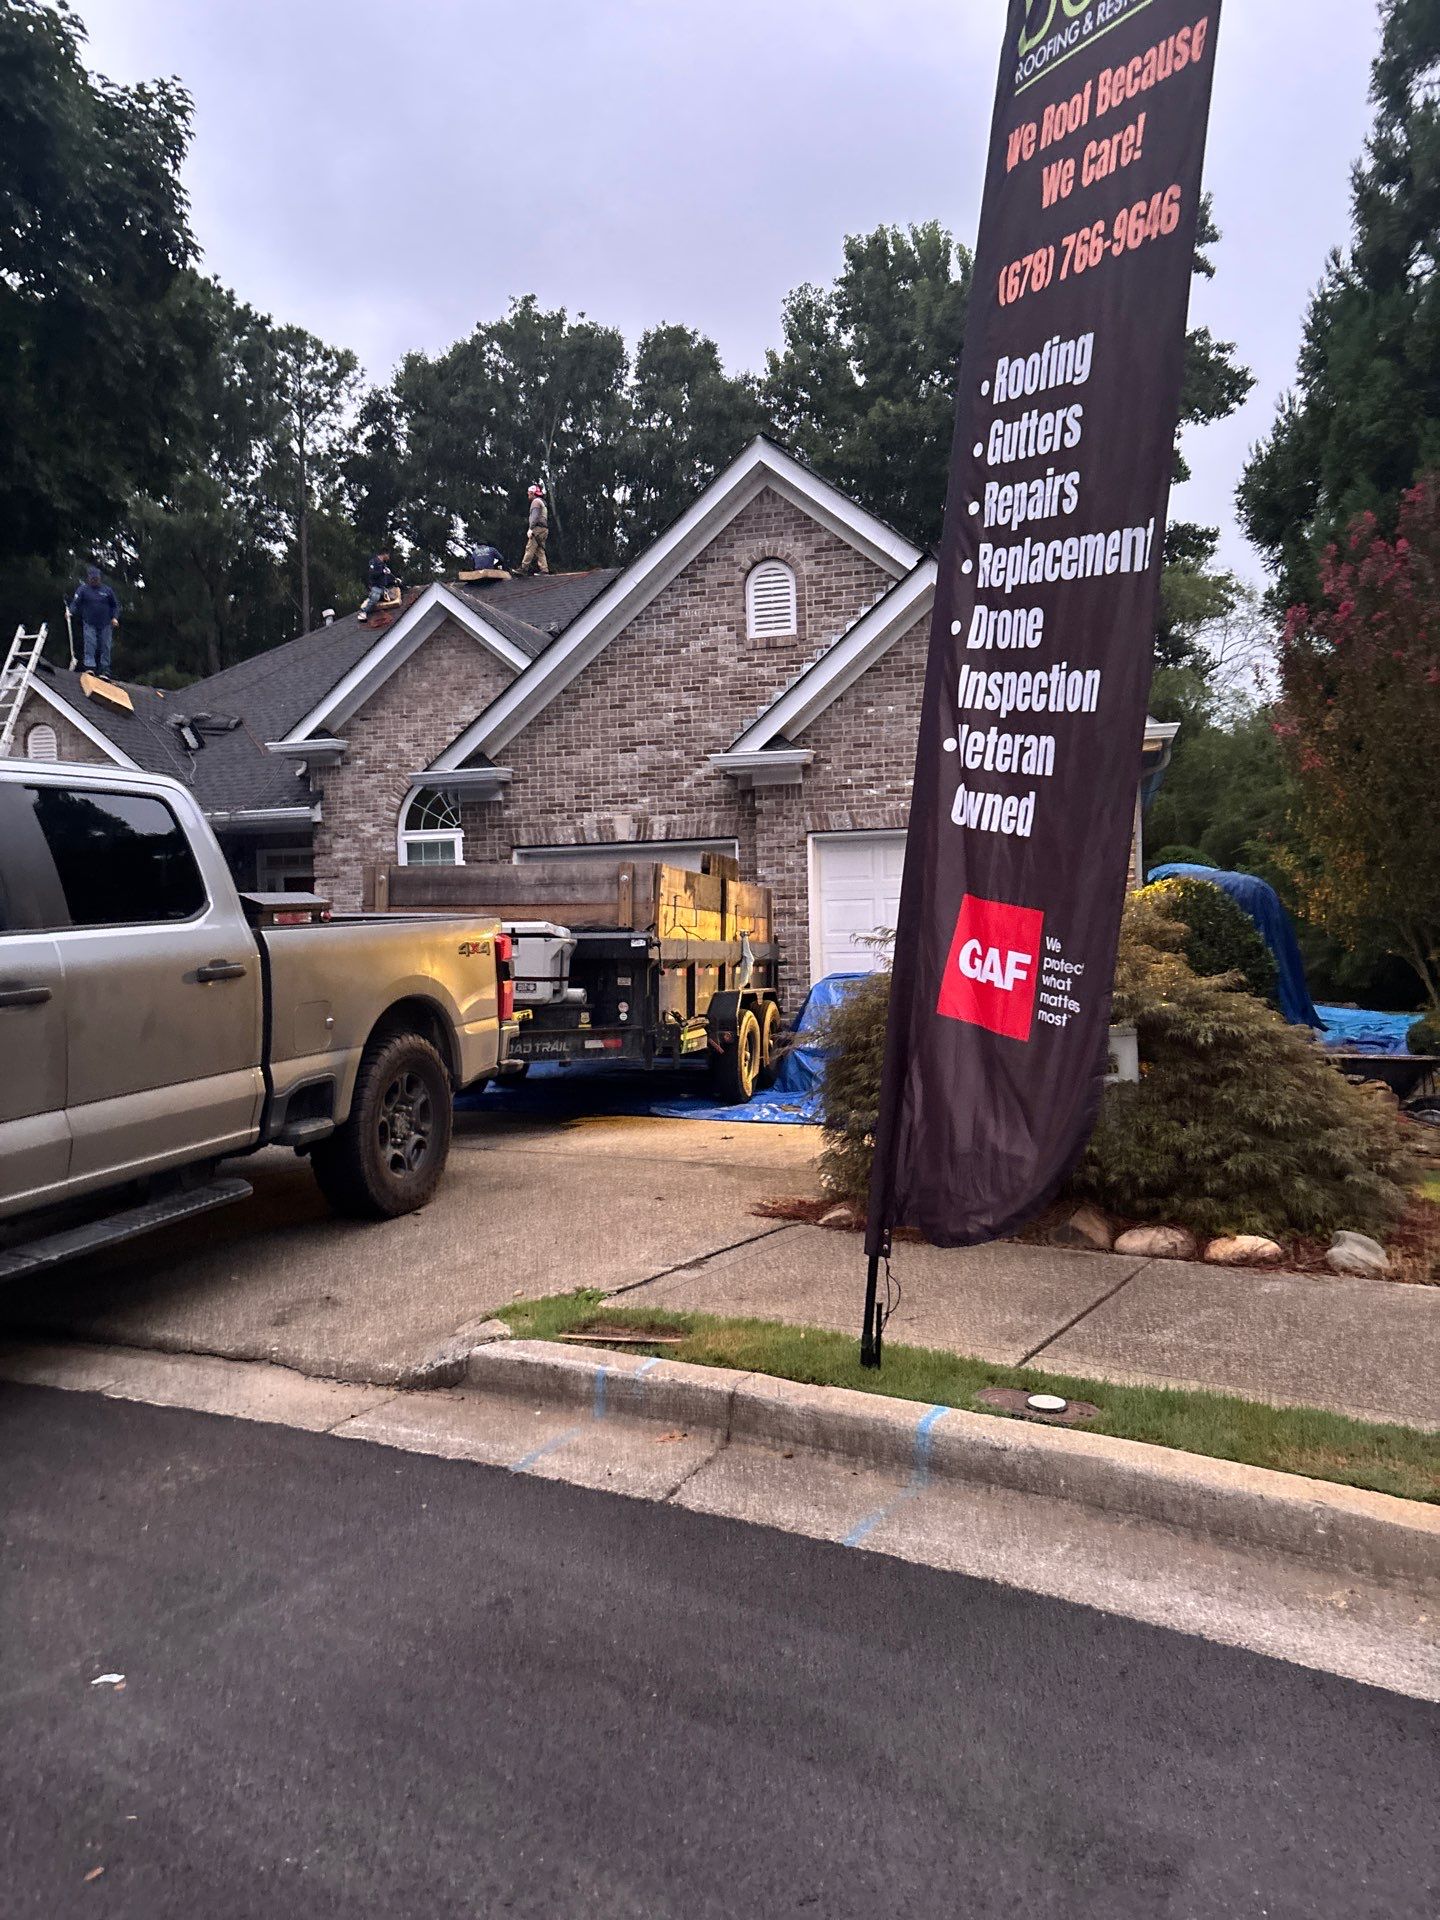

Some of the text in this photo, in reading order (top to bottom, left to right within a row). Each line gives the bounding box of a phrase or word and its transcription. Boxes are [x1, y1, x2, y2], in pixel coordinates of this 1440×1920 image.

[1014, 20, 1080, 84] ROOFING
[1082, 10, 1094, 35] &
[1097, 0, 1132, 26] RES
[1006, 122, 1037, 173] We
[1096, 16, 1208, 118] Because
[1041, 112, 1146, 209] We Care!
[998, 184, 1181, 307] (678) 766-9646
[993, 332, 1095, 404] Roofing
[987, 403, 1084, 466] Gutters
[983, 467, 1080, 531] Repairs
[977, 516, 1155, 594] Replacement
[966, 604, 1044, 649] Drone
[958, 661, 1101, 718] Inspection
[958, 723, 1056, 776] Veteran
[951, 782, 1036, 837] Owned
[958, 938, 1032, 991] GAF
[1045, 936, 1062, 953] We
[1042, 974, 1072, 991] what
[534, 1040, 570, 1053] TRAIL
